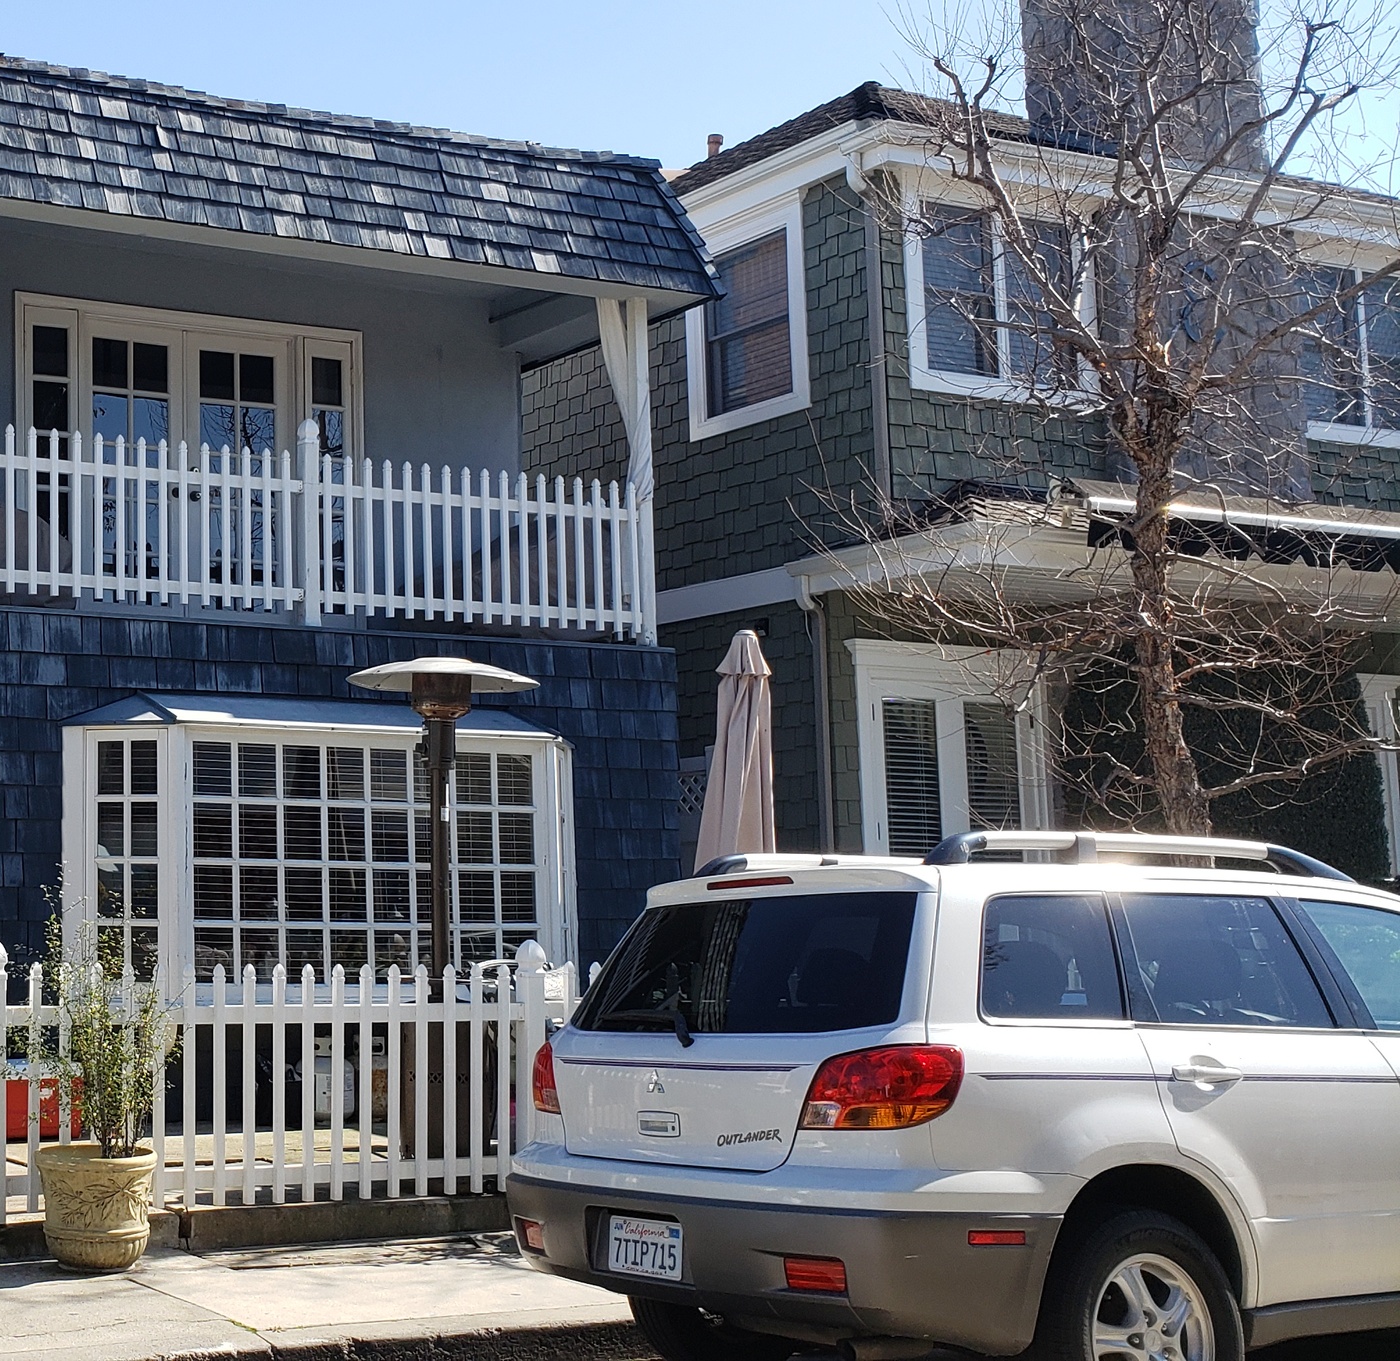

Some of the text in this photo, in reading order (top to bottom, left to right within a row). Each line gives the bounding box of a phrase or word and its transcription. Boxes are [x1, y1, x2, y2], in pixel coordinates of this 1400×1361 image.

[716, 1128, 783, 1147] OUTLANDER
[624, 1220, 670, 1239] California
[613, 1236, 677, 1272] 7TIP715
